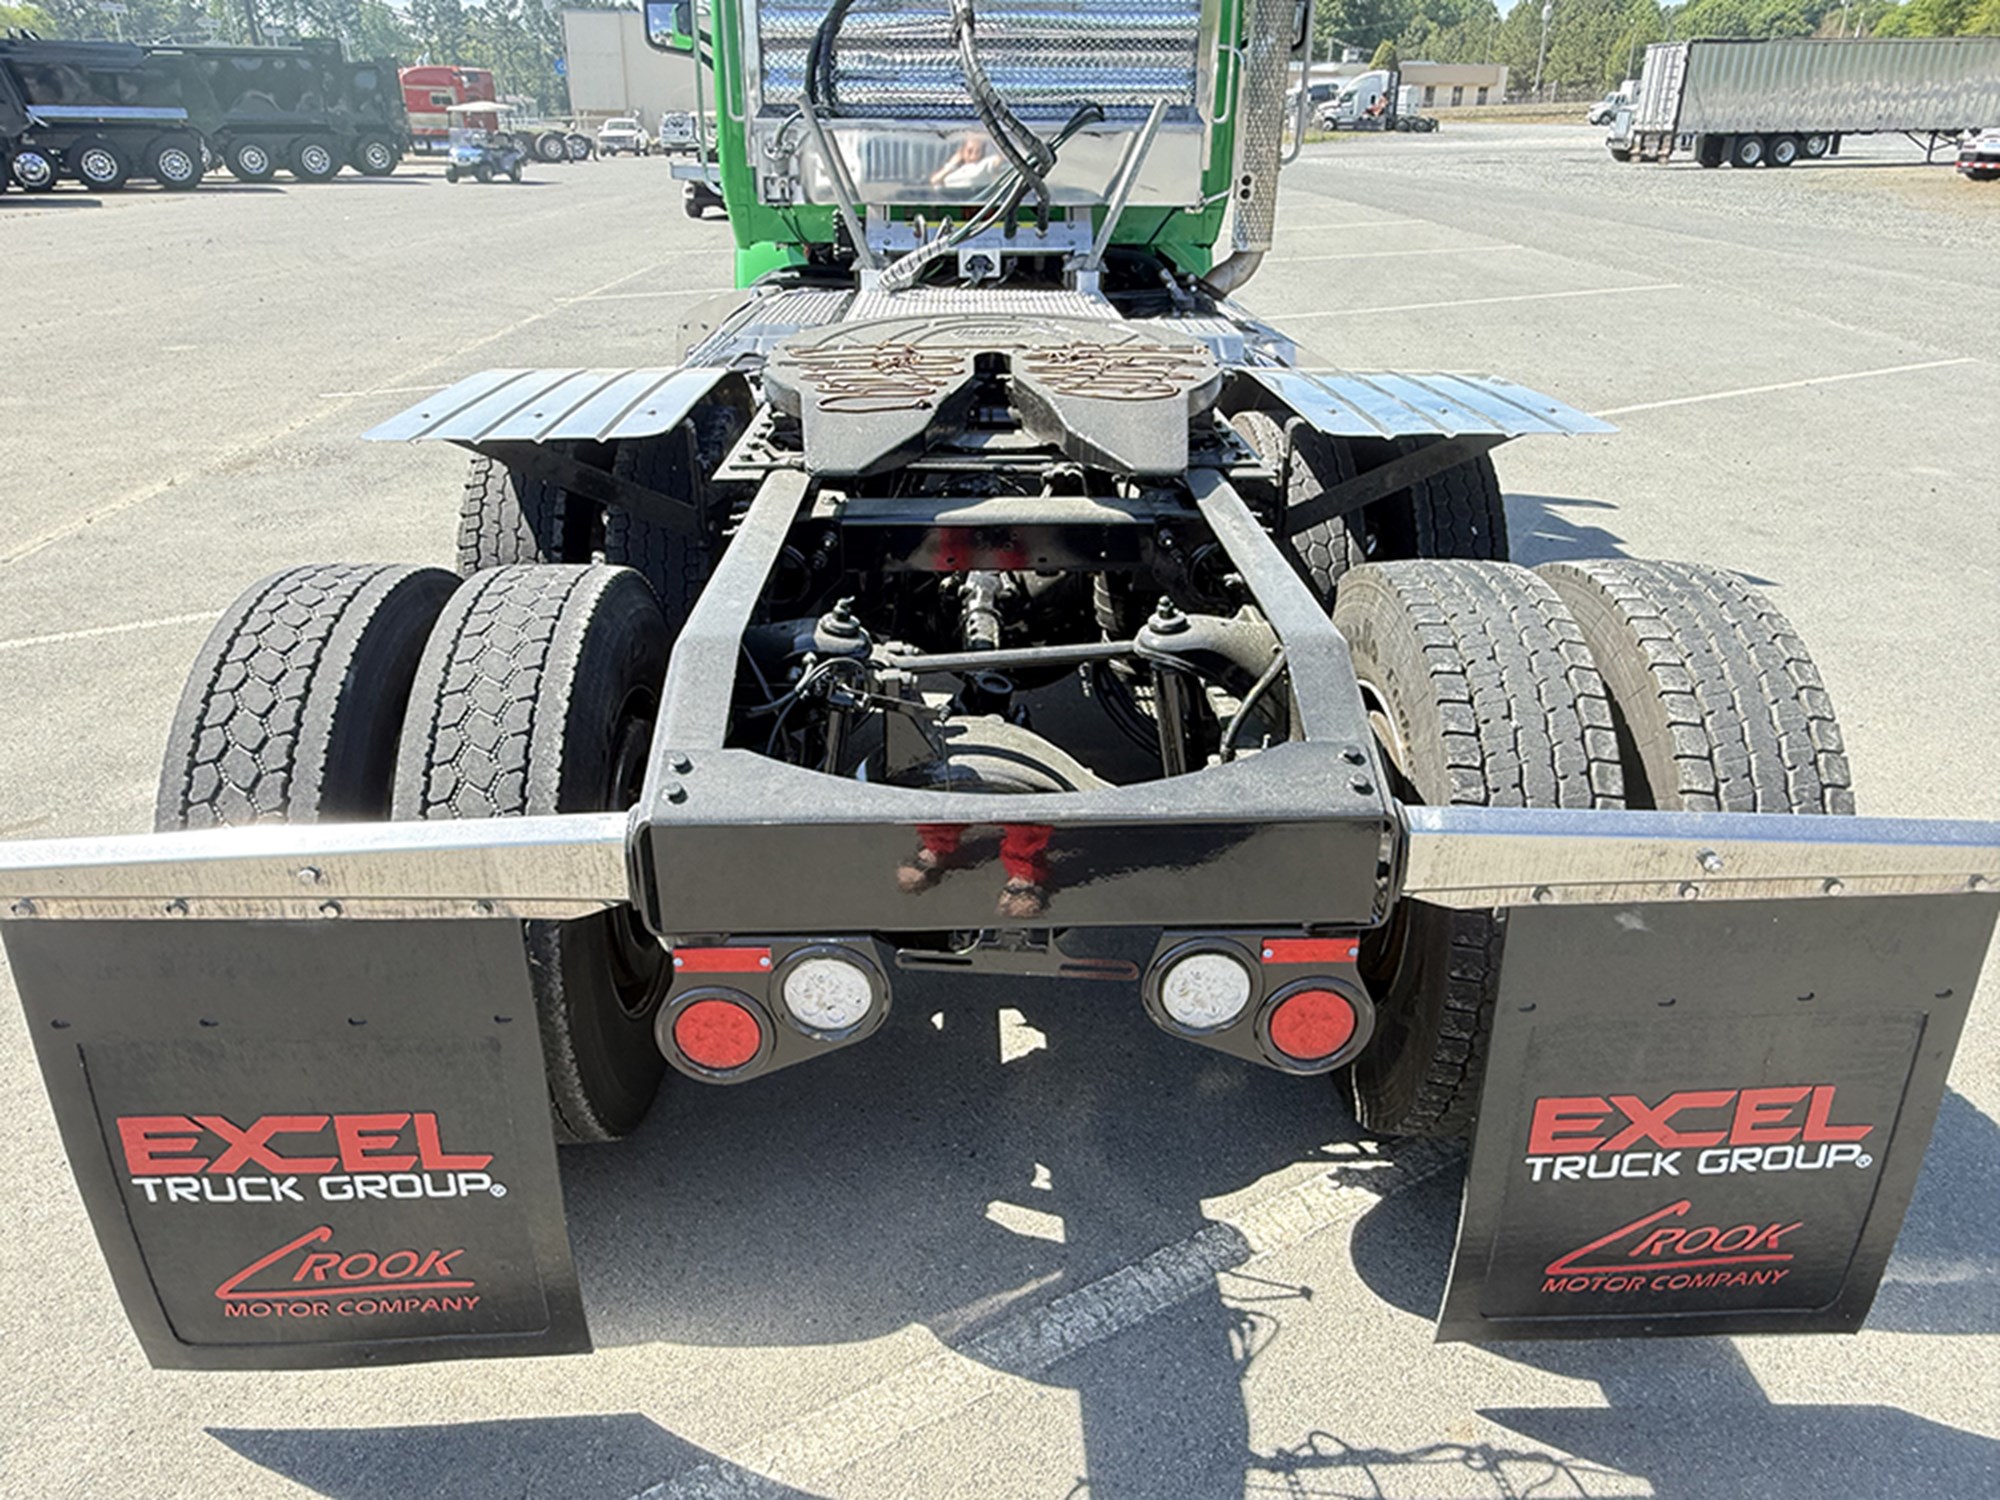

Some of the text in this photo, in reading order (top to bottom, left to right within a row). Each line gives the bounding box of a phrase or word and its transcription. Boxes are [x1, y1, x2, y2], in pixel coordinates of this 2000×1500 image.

[1527, 1084, 1874, 1155] EXCEL
[116, 1112, 494, 1176] EXCEL
[1524, 1151, 1682, 1182] TRUCK
[131, 1174, 305, 1203] TRUCK
[1540, 1269, 1790, 1294] MOTOR COMPANY
[224, 1296, 481, 1319] MOTOR COMPANY
